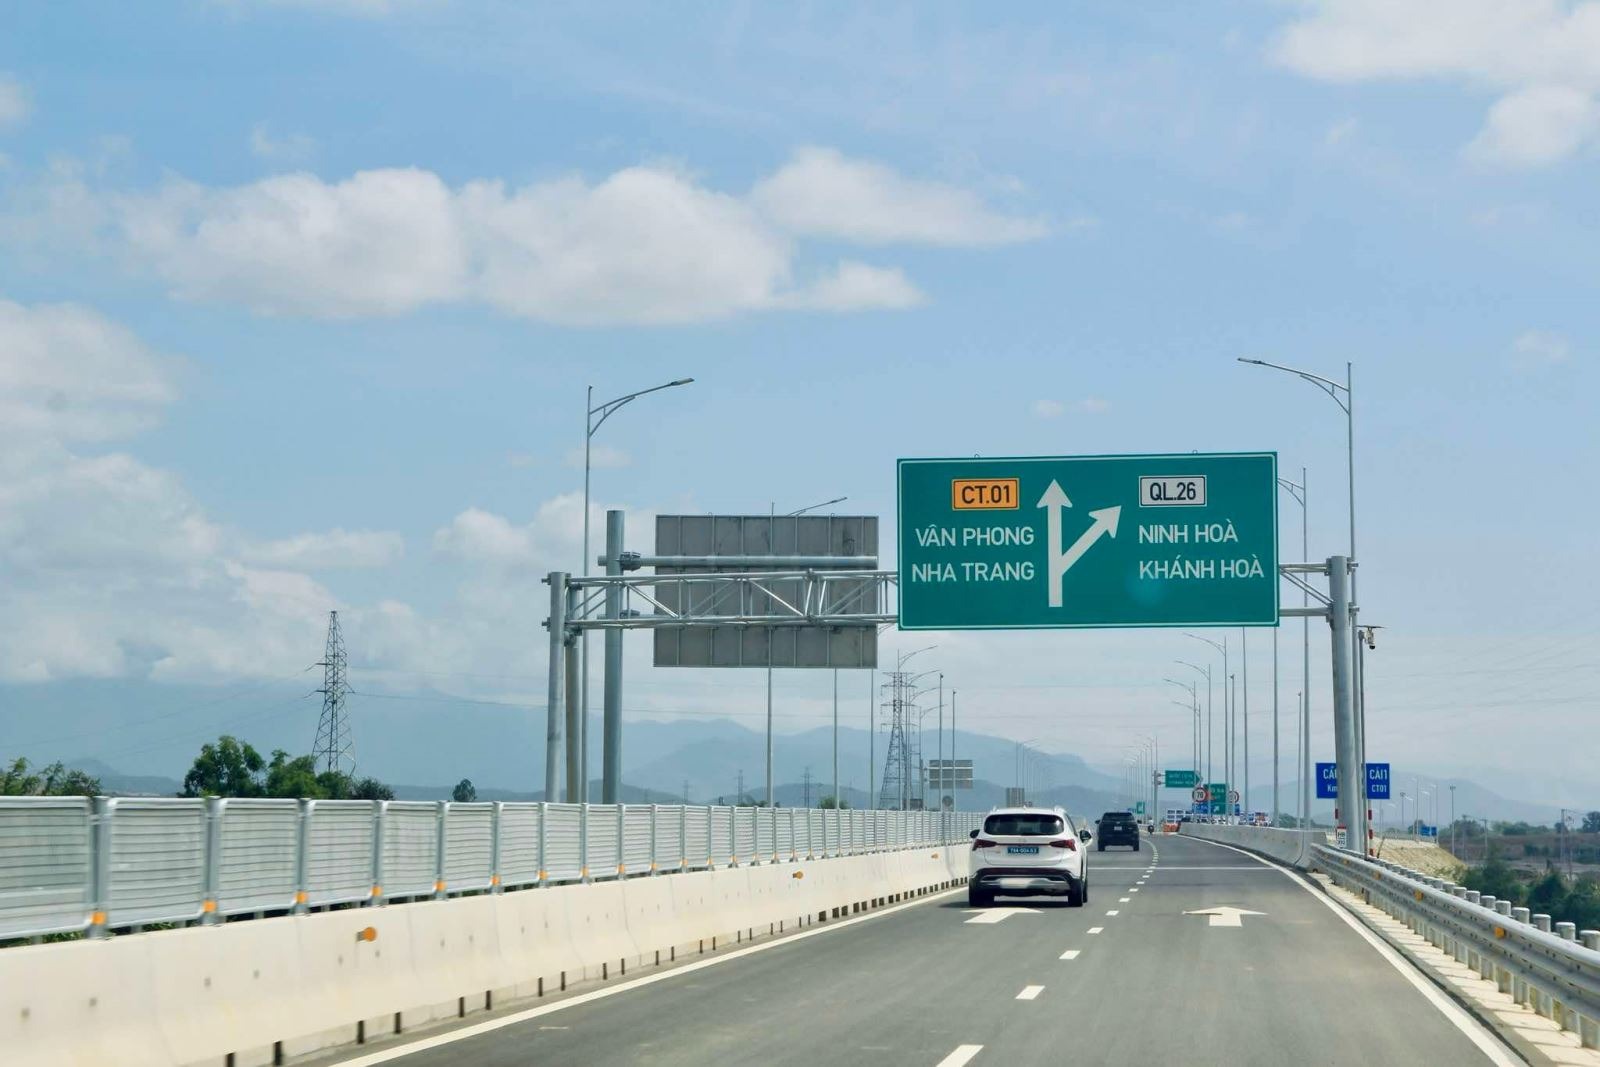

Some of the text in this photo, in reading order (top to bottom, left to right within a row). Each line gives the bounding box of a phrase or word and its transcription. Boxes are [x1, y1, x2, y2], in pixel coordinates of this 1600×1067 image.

[961, 485, 1011, 504] CT.01
[1149, 482, 1196, 502] QL.26
[915, 524, 1034, 547] VÂN PHONG
[1139, 518, 1238, 544] NINH HOÀ
[911, 561, 1035, 583] NHA TRANG
[1139, 554, 1264, 579] KHÁNH HOÀ
[1371, 784, 1387, 793] CT01
